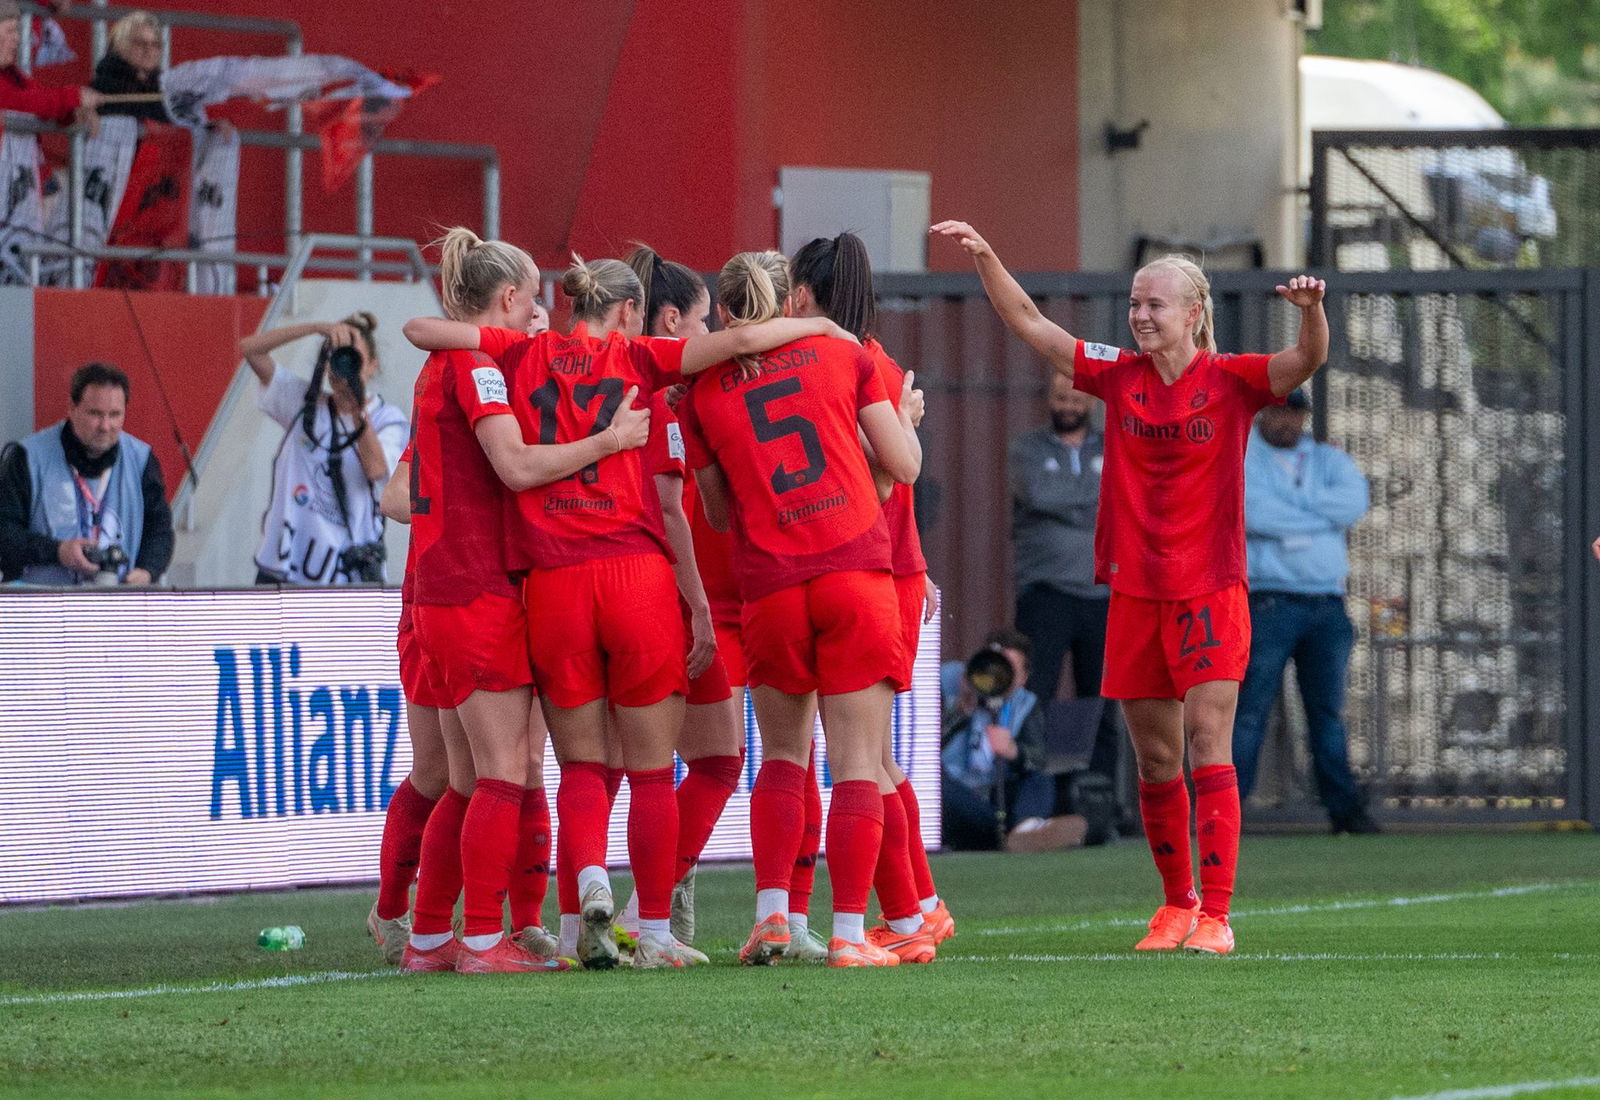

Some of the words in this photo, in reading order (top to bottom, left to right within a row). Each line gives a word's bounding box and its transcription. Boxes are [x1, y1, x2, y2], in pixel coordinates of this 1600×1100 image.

[550, 351, 592, 376] BÜHL
[529, 377, 624, 484] 17
[743, 375, 828, 495] 5
[1121, 412, 1181, 440] Allianz
[545, 495, 615, 511] Ehrmann
[777, 494, 848, 526] Ehrmann
[1176, 605, 1222, 658] 21
[209, 642, 401, 821] Allianz
